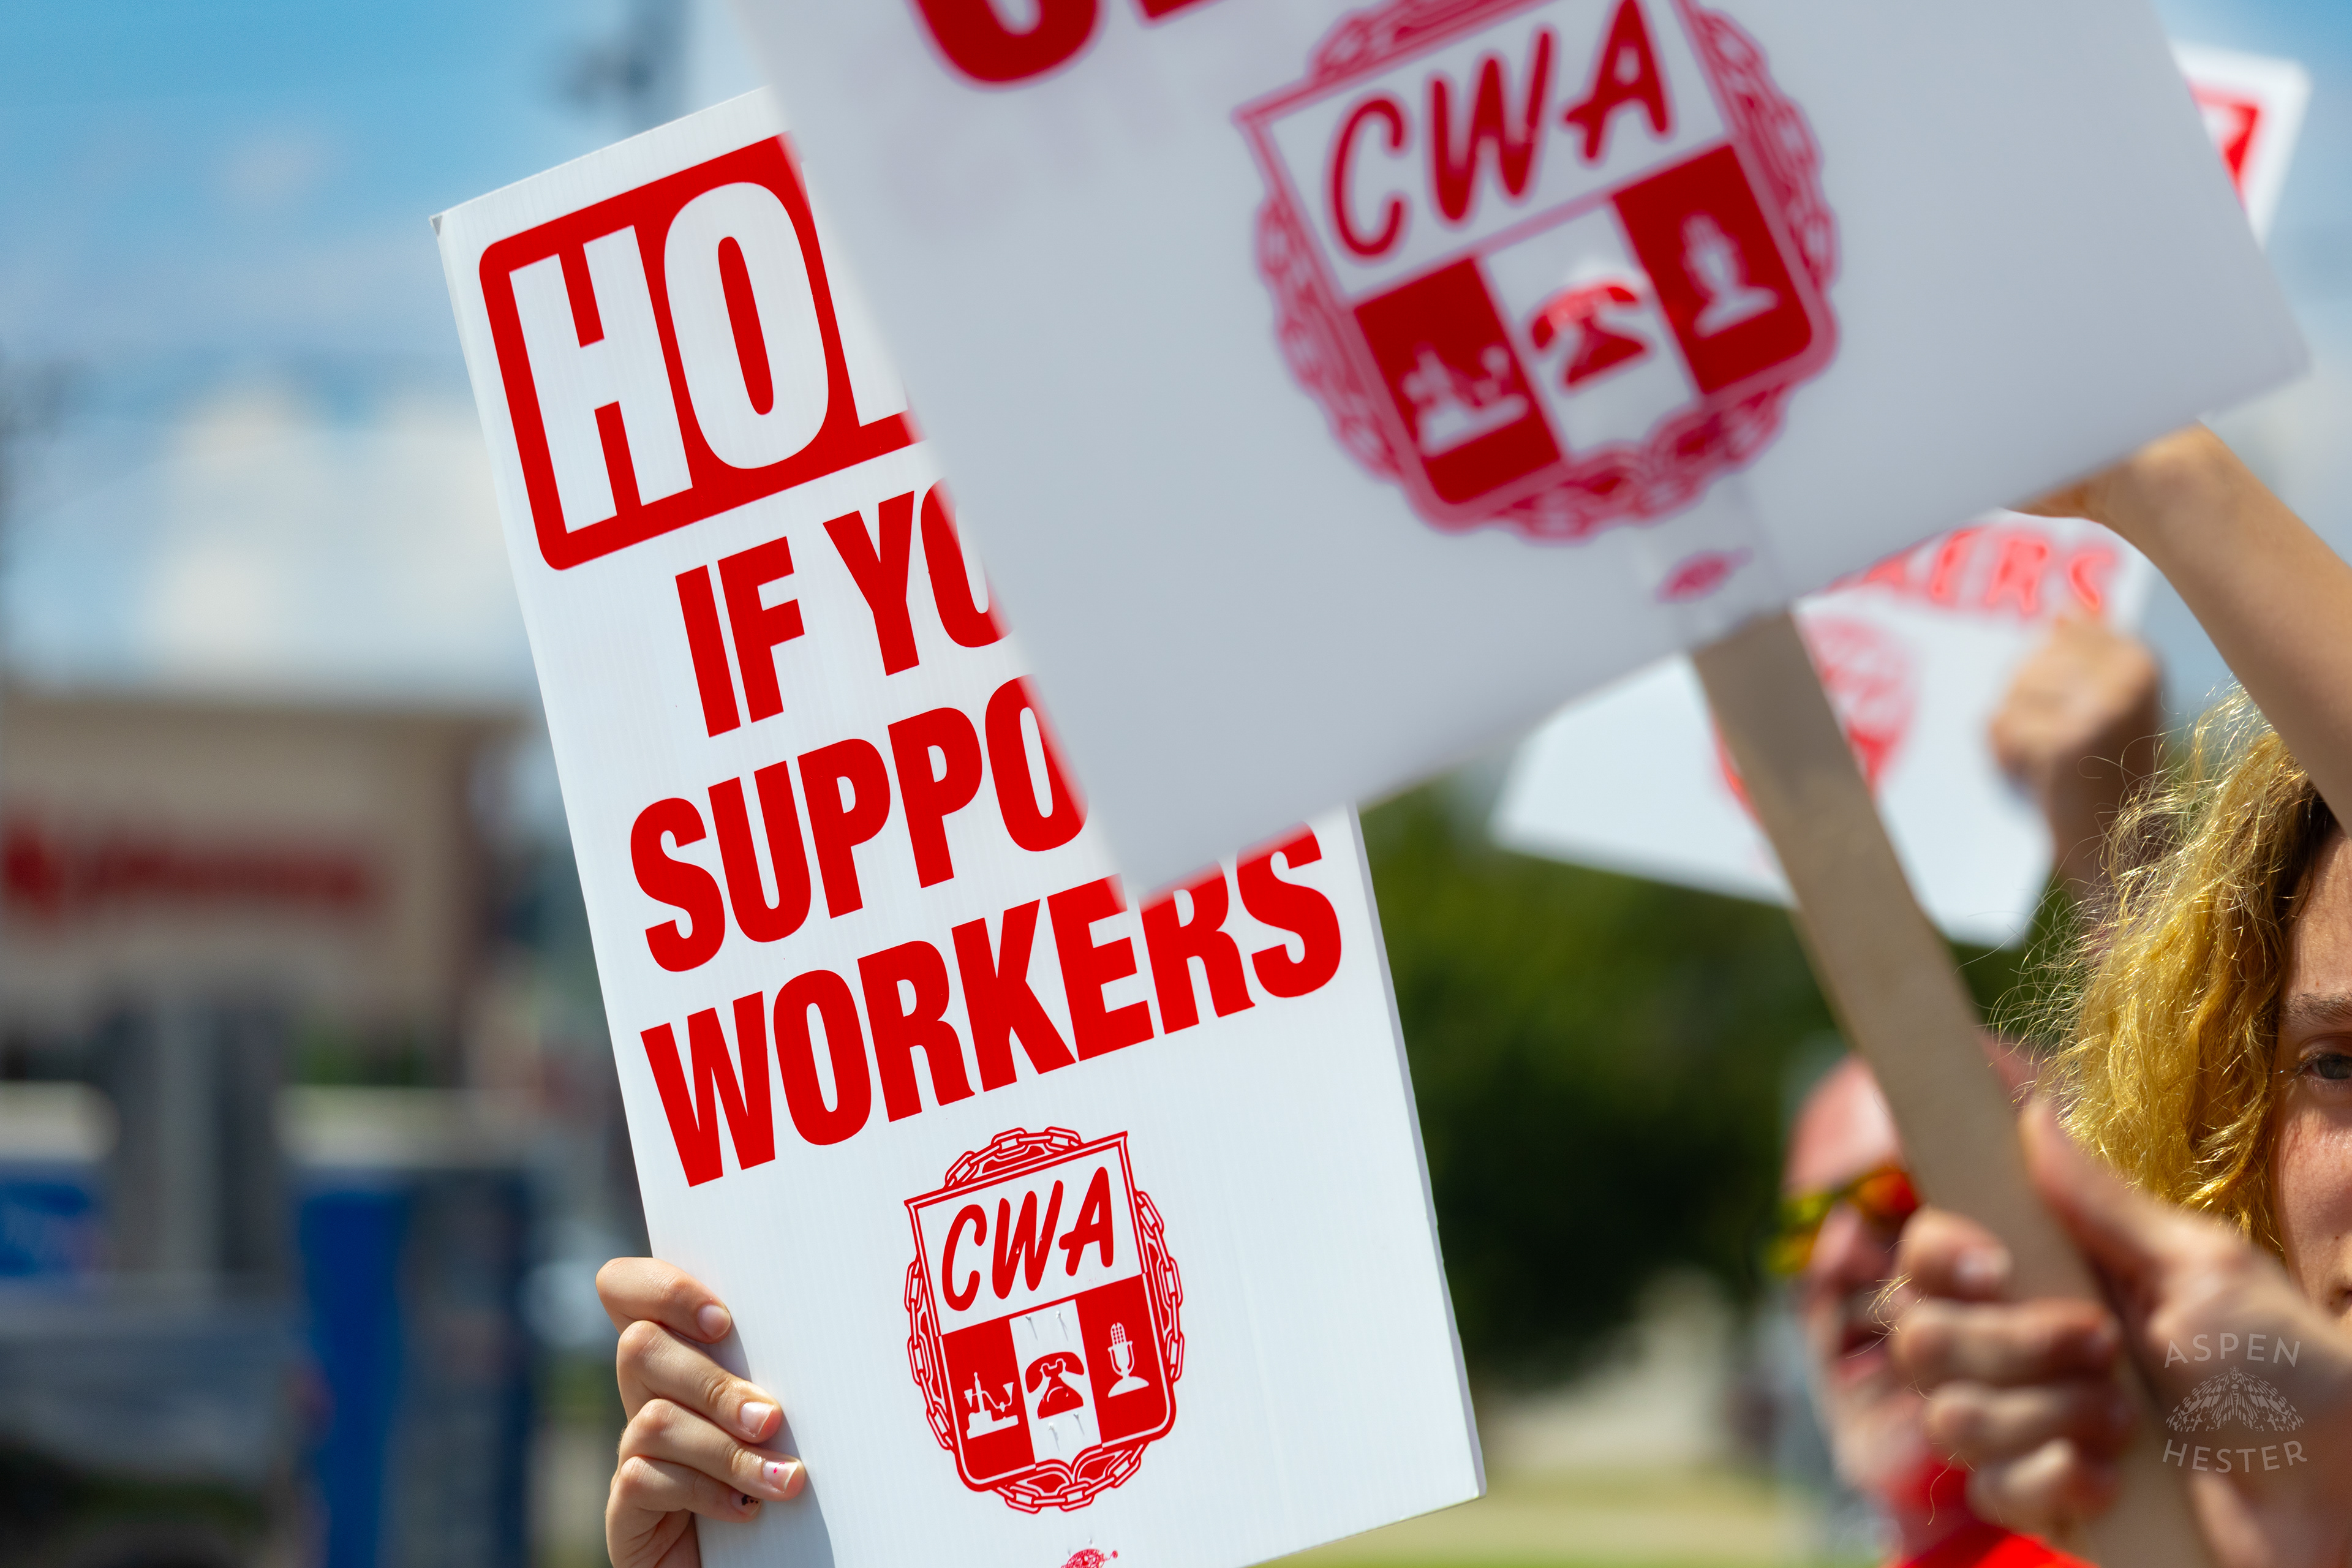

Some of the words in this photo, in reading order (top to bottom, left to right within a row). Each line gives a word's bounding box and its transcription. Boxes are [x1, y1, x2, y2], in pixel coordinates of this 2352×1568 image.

[1326, 0, 1677, 260] CWA
[675, 537, 805, 738] IF
[630, 674, 1089, 973] SUPPO
[640, 820, 1342, 1187] WORKERS
[941, 1166, 1115, 1311] CWA
